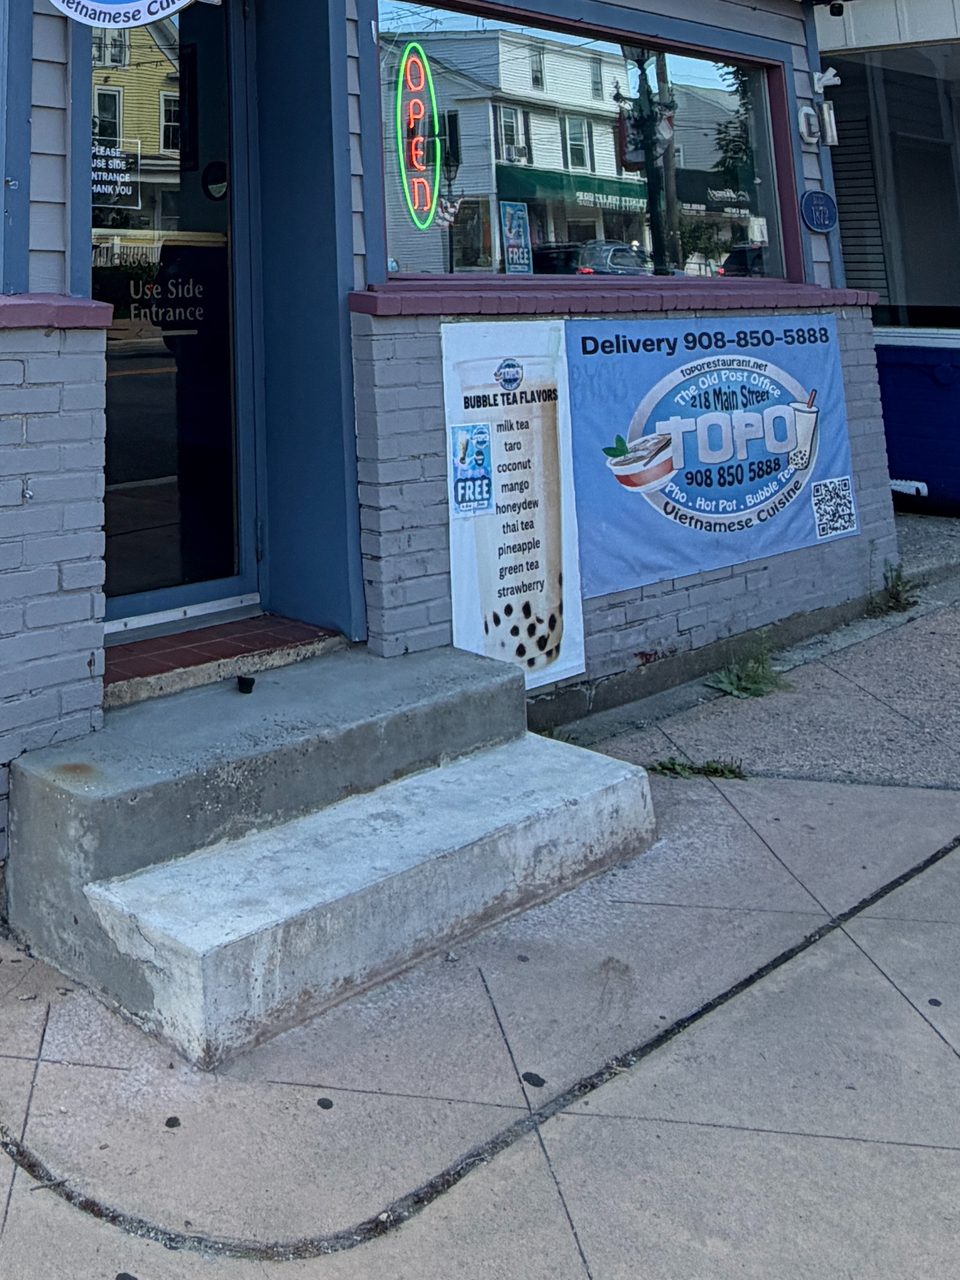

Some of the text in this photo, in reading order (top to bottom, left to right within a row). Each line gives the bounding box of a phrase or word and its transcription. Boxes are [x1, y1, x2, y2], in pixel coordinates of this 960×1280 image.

[108, 159, 126, 169] SIDE
[91, 171, 130, 182] NTRANCE
[91, 184, 132, 195] HANK YOU
[508, 247, 529, 265] FREE
[130, 278, 203, 299] Use Side
[130, 303, 204, 322] Entrance
[581, 327, 829, 356] Delivery 908-850-5888
[680, 358, 768, 378] toporestaurant.net
[464, 388, 558, 409] BUBBLE TEA FLAVORS
[674, 370, 782, 407] The Old Post Office
[690, 385, 770, 411] 218 Main Street
[496, 420, 529, 433] milk tea
[504, 440, 522, 452] taro
[656, 405, 798, 470] TOPO
[497, 458, 531, 473] coconut
[685, 457, 781, 487] 908 850 5888
[457, 480, 490, 502] FREE
[501, 479, 529, 494] mango
[665, 464, 797, 512] Pho Hot Pot Bubble Tea
[495, 498, 539, 515] honeydew
[663, 479, 803, 532] Vietnamese Cuisine
[502, 519, 534, 535] thai tea
[498, 537, 540, 560] pineapple
[499, 559, 539, 580] green tea
[497, 578, 545, 599] strawberry
